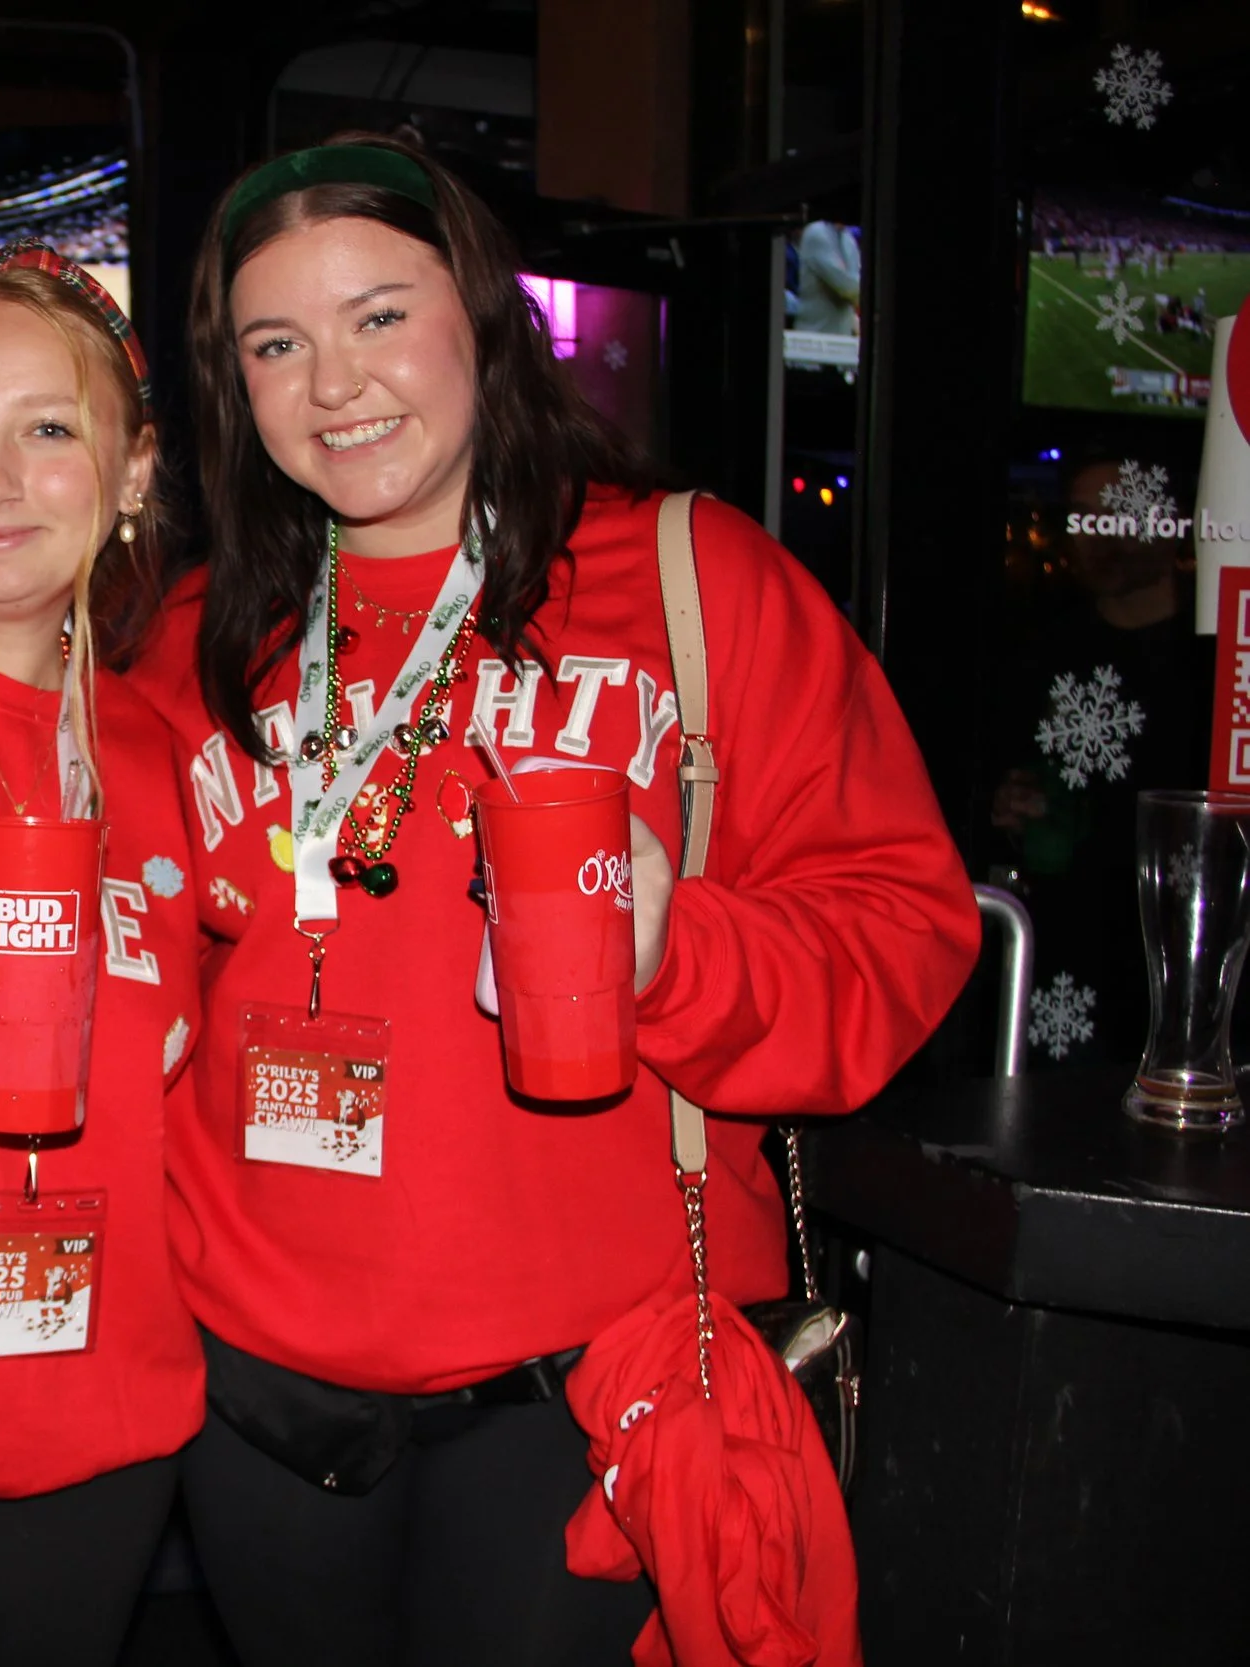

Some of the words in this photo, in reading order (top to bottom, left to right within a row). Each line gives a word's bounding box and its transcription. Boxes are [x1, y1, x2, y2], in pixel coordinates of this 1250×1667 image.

[1066, 512, 1137, 538] scan
[1147, 506, 1193, 539] for
[190, 655, 677, 852] NAHTY
[256, 1063, 319, 1083] O'RILEY'S
[352, 1064, 377, 1080] VIP
[255, 1077, 319, 1106] 2025
[255, 1100, 292, 1116] SANTA
[295, 1106, 317, 1118] PUB
[254, 1111, 318, 1136] CRAWL
[63, 1239, 89, 1253] VIP
